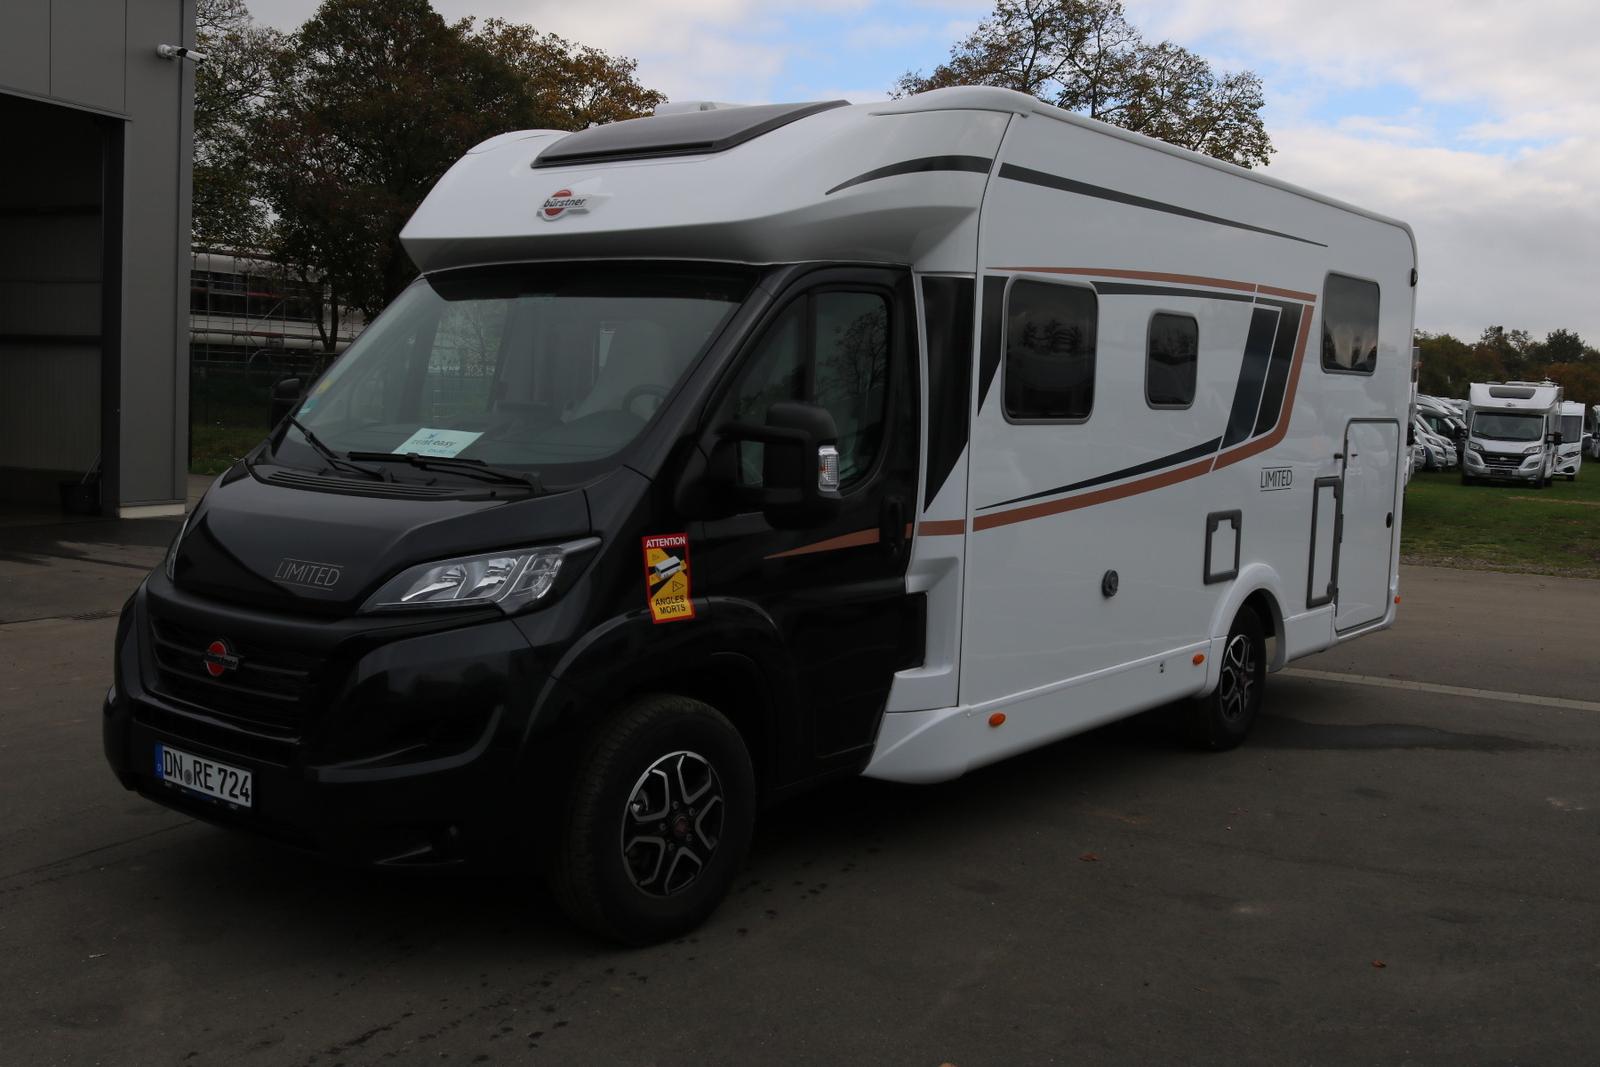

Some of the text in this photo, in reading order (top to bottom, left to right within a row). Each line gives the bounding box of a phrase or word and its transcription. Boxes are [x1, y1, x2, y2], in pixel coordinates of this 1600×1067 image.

[543, 198, 587, 208] bürstner
[1260, 469, 1293, 488] LIMITED
[646, 536, 686, 548] ATTENTION
[274, 561, 340, 586] LIMITED
[656, 595, 685, 607] ANGLES
[659, 604, 686, 614] MORTS
[164, 750, 183, 781] DN
[193, 759, 215, 792] RE
[218, 767, 251, 803] 724
